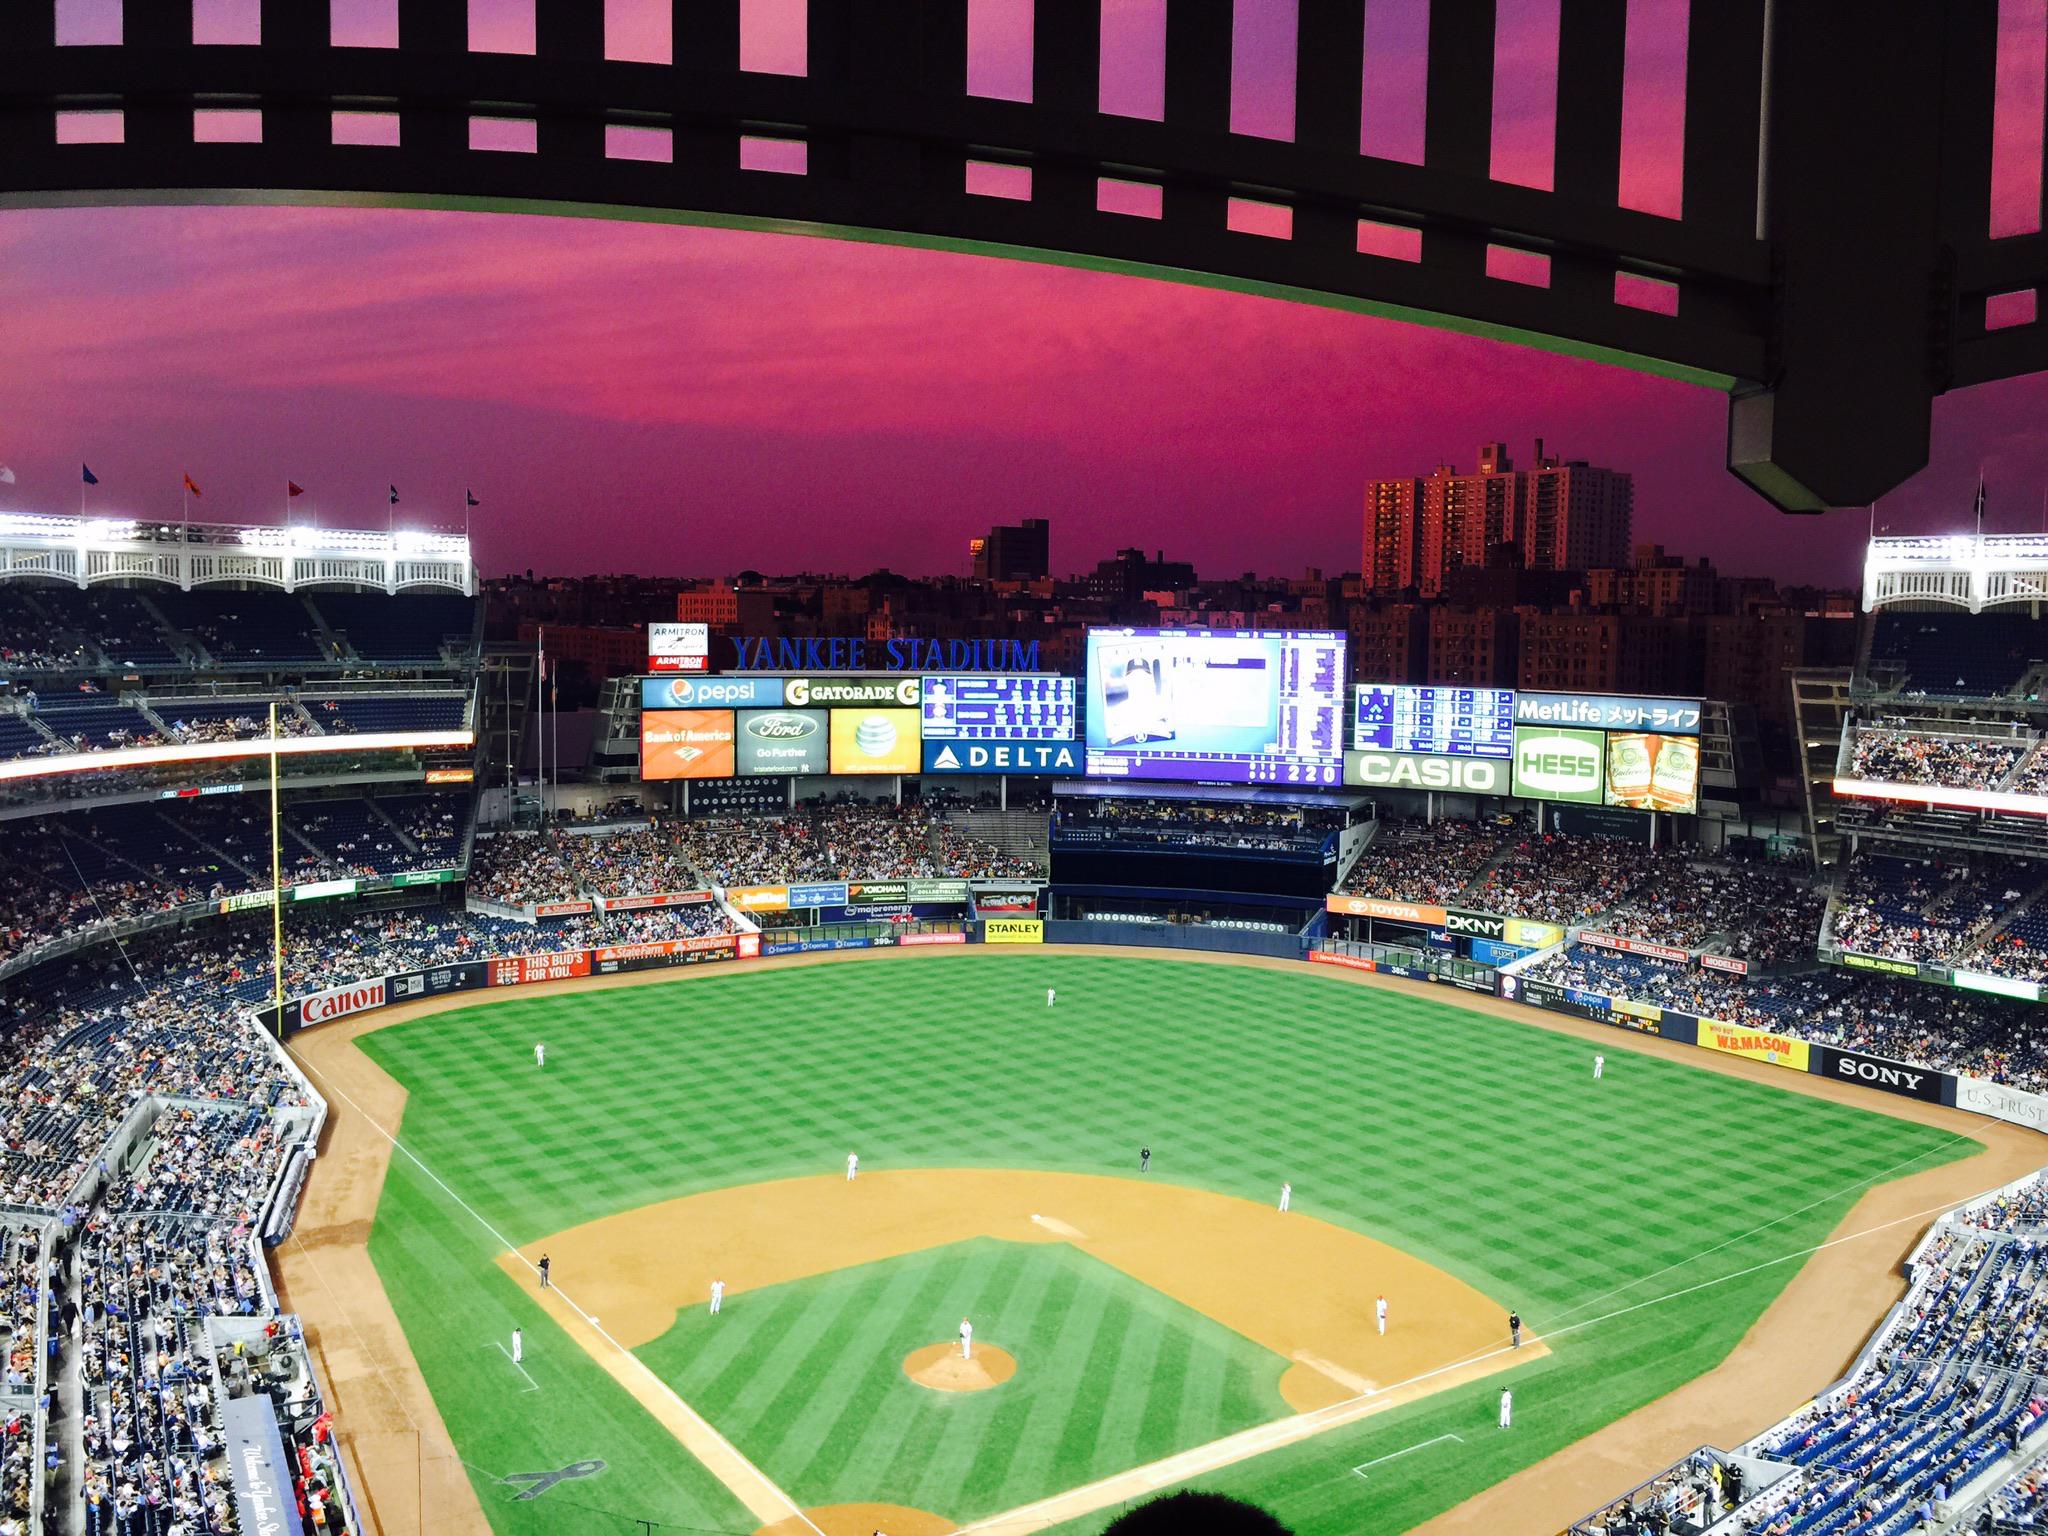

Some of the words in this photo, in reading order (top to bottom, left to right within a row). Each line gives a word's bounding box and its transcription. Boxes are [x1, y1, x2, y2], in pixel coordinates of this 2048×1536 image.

[654, 628, 705, 636] ARMITRON
[656, 656, 704, 666] ARMITRON
[729, 636, 866, 671] YANKEE
[886, 637, 1041, 672] STADIUM
[698, 681, 755, 704] pepsi
[811, 687, 896, 701] GATORADE
[1518, 699, 1601, 723] MetLife
[1607, 705, 1700, 728] メットライフ
[759, 716, 804, 737] Ford
[687, 729, 732, 743] America
[757, 748, 771, 758] Go
[969, 746, 1075, 768] DELTA
[1359, 754, 1496, 790] CASIO
[1522, 751, 1596, 778] HESS
[1287, 765, 1300, 782] 2
[1304, 765, 1318, 782] 2
[862, 884, 906, 894] YOKOHAMA
[1371, 903, 1420, 918] TOYOTA
[988, 924, 1039, 933] STANLEY
[1446, 915, 1504, 936] DKNY
[1431, 930, 1452, 943] FedEx
[525, 956, 550, 969] THIS
[552, 952, 584, 966] BUD'S
[1865, 958, 1918, 976] BUSINESS
[525, 968, 546, 981] FOR
[548, 965, 573, 978] YOU.
[302, 984, 385, 1023] Canon
[1583, 995, 1603, 1005] pepsi
[1838, 1057, 1924, 1090] SONY
[1999, 1098, 2046, 1122] TRUST
